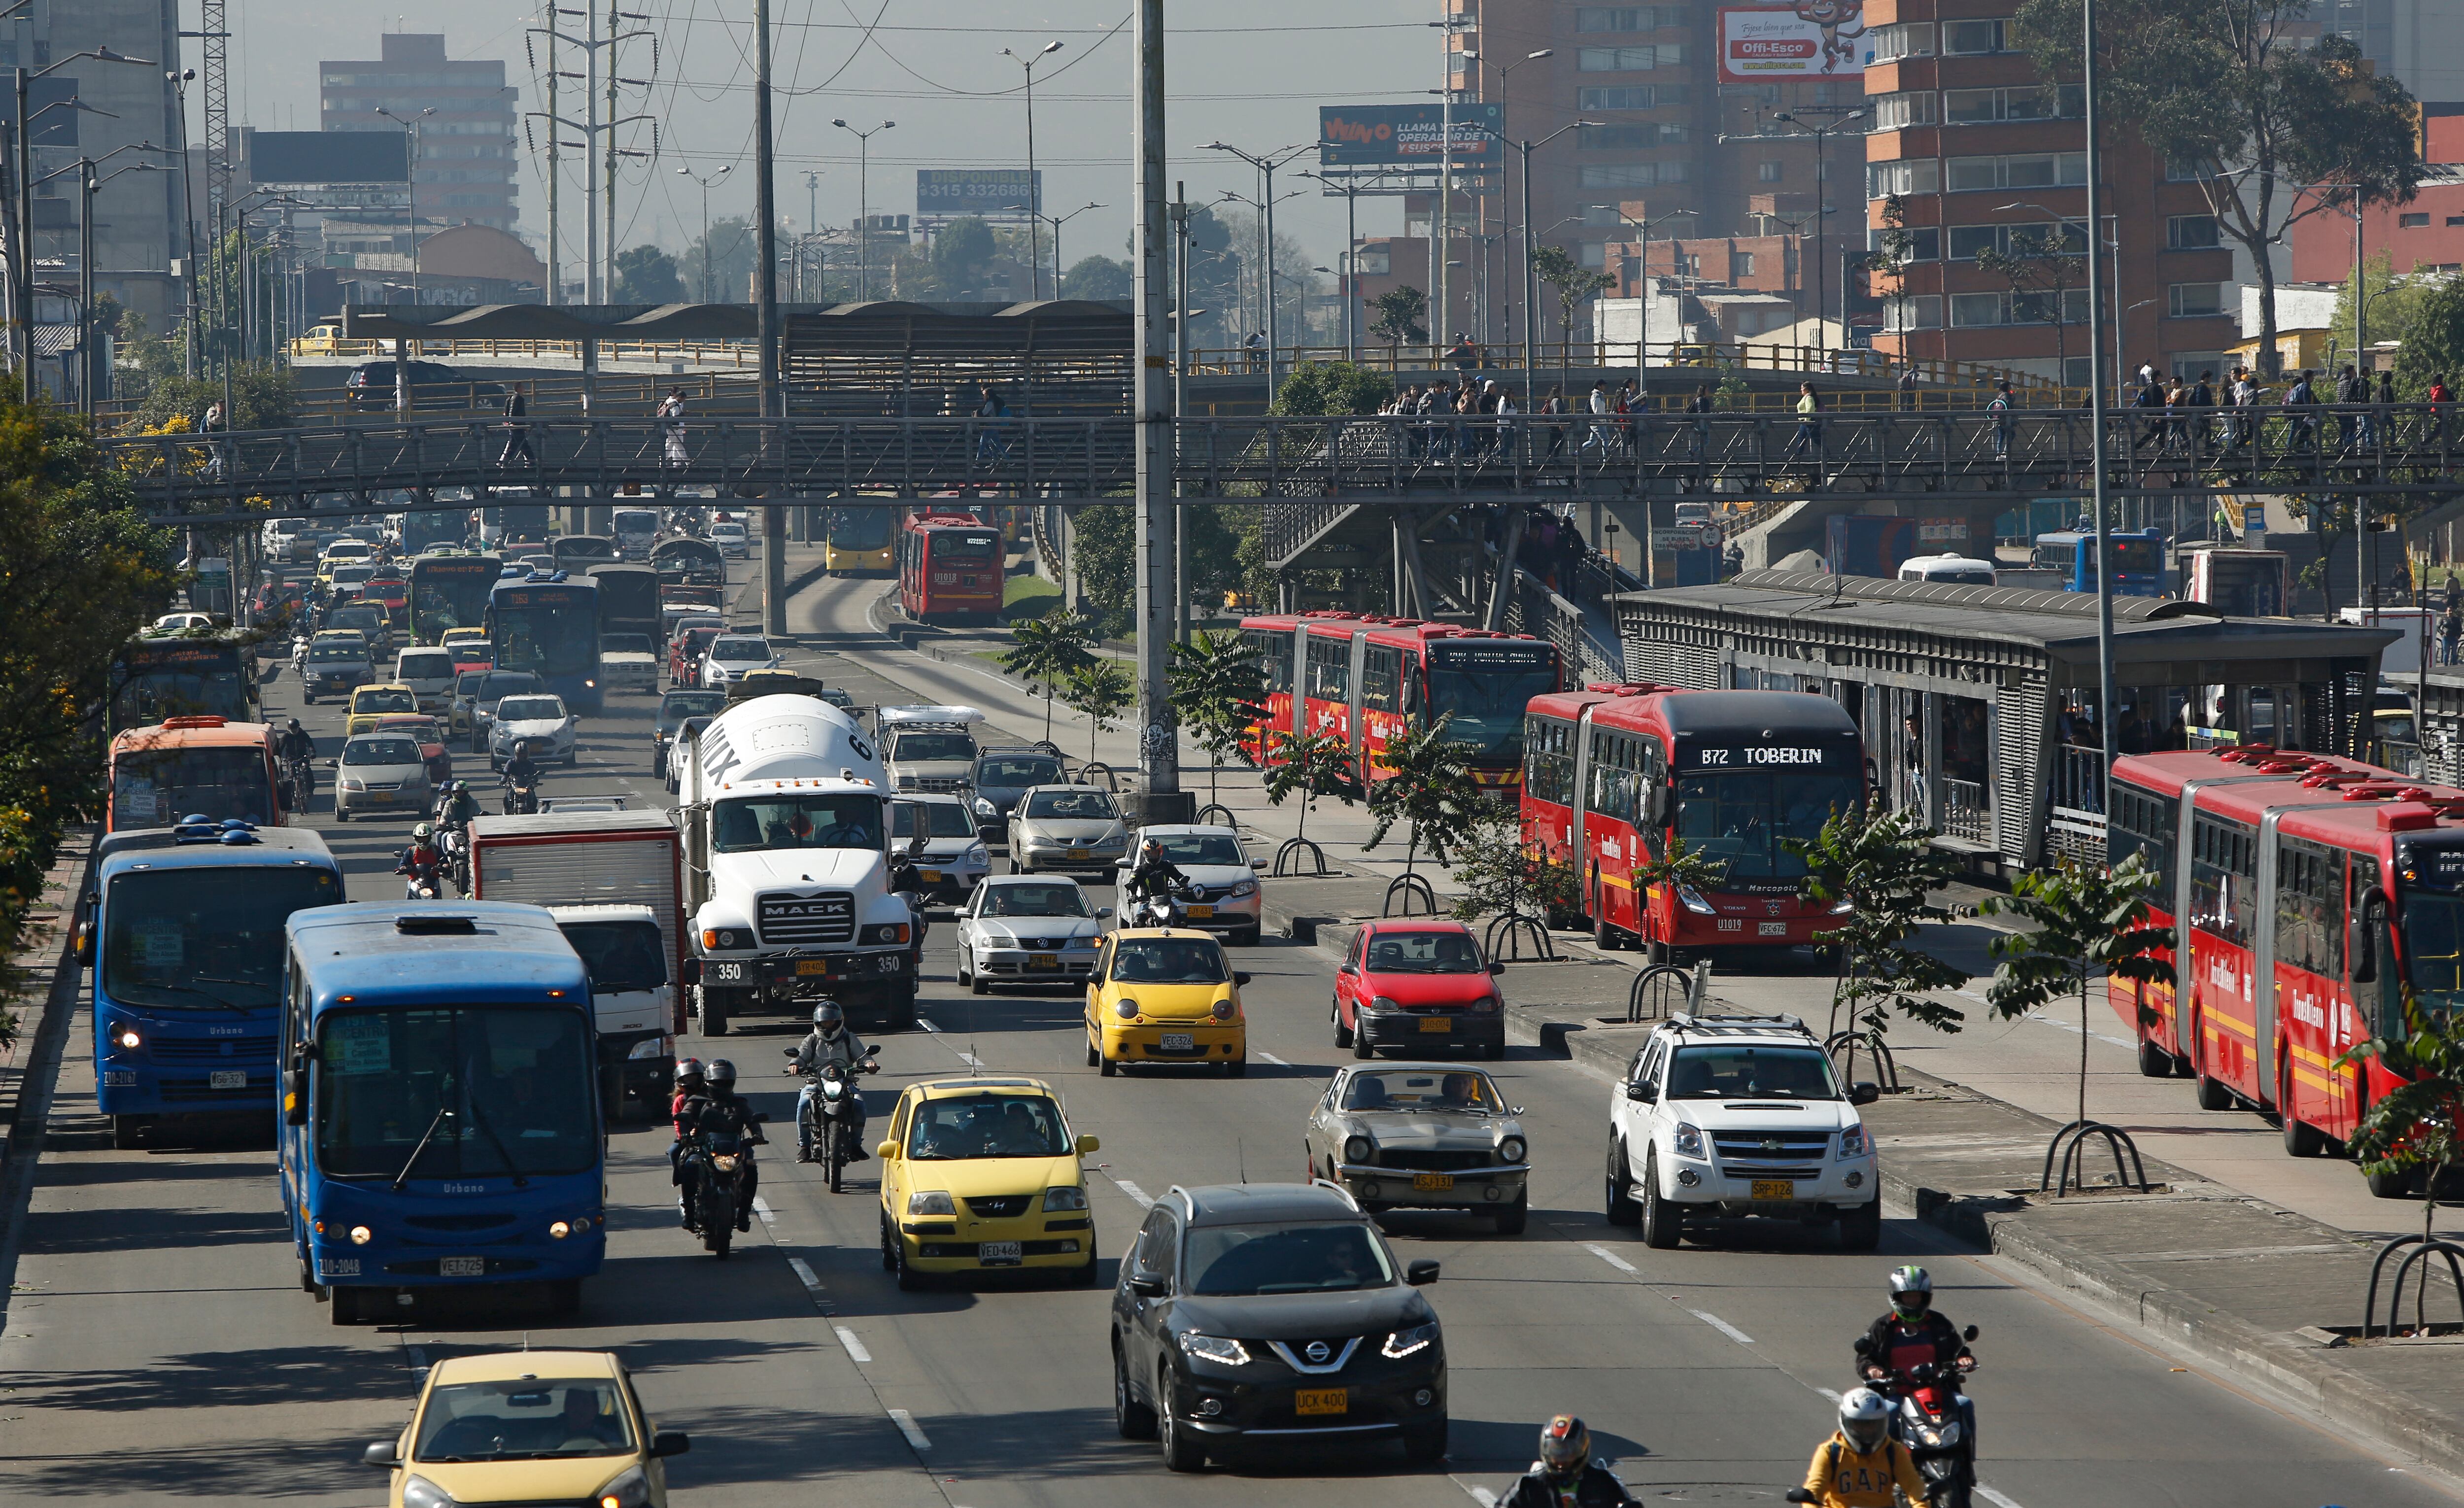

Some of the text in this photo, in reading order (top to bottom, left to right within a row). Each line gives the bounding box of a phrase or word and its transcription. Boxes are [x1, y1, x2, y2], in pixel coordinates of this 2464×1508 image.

[1764, 21, 1779, 32] bien
[1780, 25, 1793, 35] que
[1743, 43, 1804, 53] Offi-Esco
[1397, 123, 1439, 132] LLAMA
[1397, 132, 1464, 141] OPERADOR
[1464, 132, 1480, 141] DE
[931, 171, 1029, 183] DISPONIBLE
[930, 184, 961, 197] 315
[935, 573, 957, 582] U1018
[511, 593, 529, 604] T163
[1701, 747, 1822, 764] B72 TOBERIN
[1601, 833, 1621, 860] TransMilenio
[765, 905, 847, 915] MACK
[1718, 919, 1741, 929] U1019
[878, 956, 899, 973] 350
[719, 963, 741, 980] 350
[2211, 956, 2235, 994] TransMilenio
[2293, 988, 2324, 1029] TransMilenio
[210, 1026, 243, 1034] Urbano
[351, 1048, 382, 1058] Castilla
[104, 1072, 136, 1084] Z10-2167
[444, 1183, 484, 1193] Urbano
[319, 1259, 360, 1273] Z10-2048
[1838, 1469, 1888, 1495] GAP
